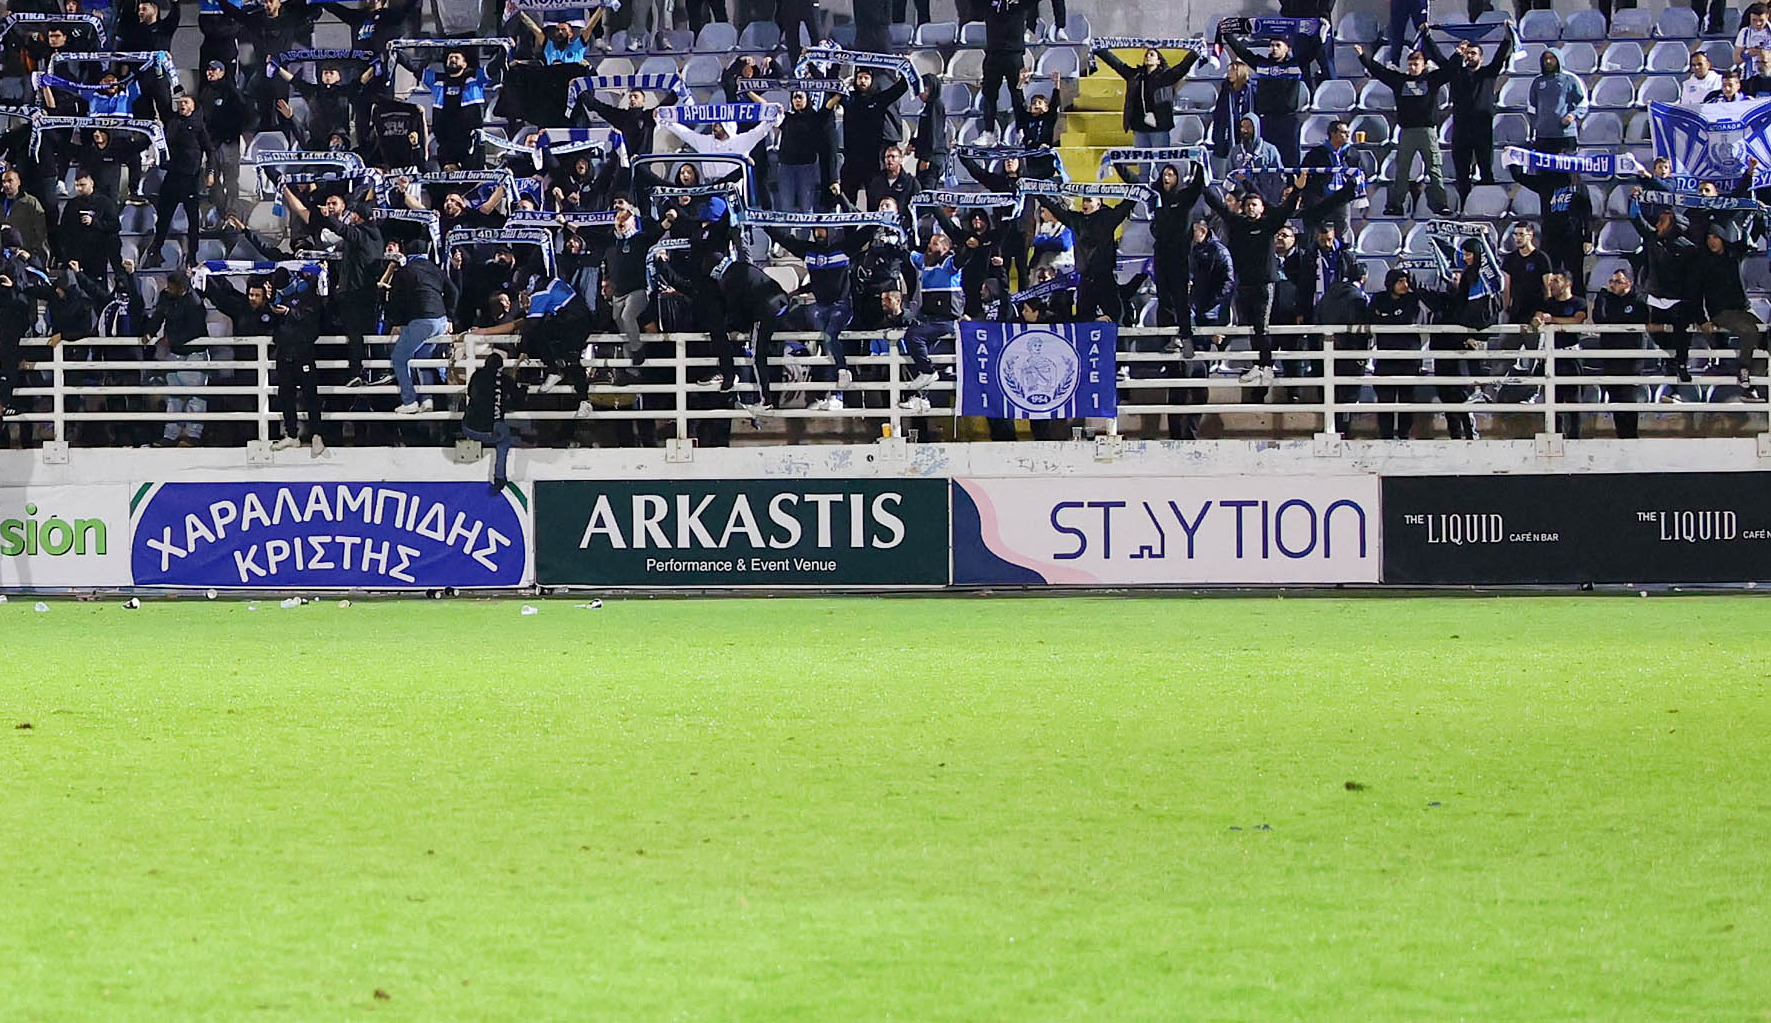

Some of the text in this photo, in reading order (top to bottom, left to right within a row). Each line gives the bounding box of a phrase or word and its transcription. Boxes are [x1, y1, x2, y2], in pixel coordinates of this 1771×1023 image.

[684, 103, 755, 120] APOLLON FC
[1555, 154, 1609, 173] APOLLON
[937, 193, 953, 203] 40
[1064, 184, 1079, 192] 40
[477, 230, 493, 239] 40
[976, 329, 989, 408] GATE 1
[1089, 329, 1102, 408] GATE 1
[147, 484, 511, 573] ΧΑΡΑΛΑΜΠΙΔΗΣ
[578, 492, 906, 550] ARKASTIS
[1404, 513, 1559, 545] THE LIQUID CAFÉ N BAR
[1636, 511, 1657, 522] THE
[1660, 509, 1737, 543] LIQUID
[1742, 528, 1766, 540] CAFÉ
[233, 535, 421, 584] ΚΡΙΣΤΗΣ
[646, 557, 837, 572] Performance & Event Venue
